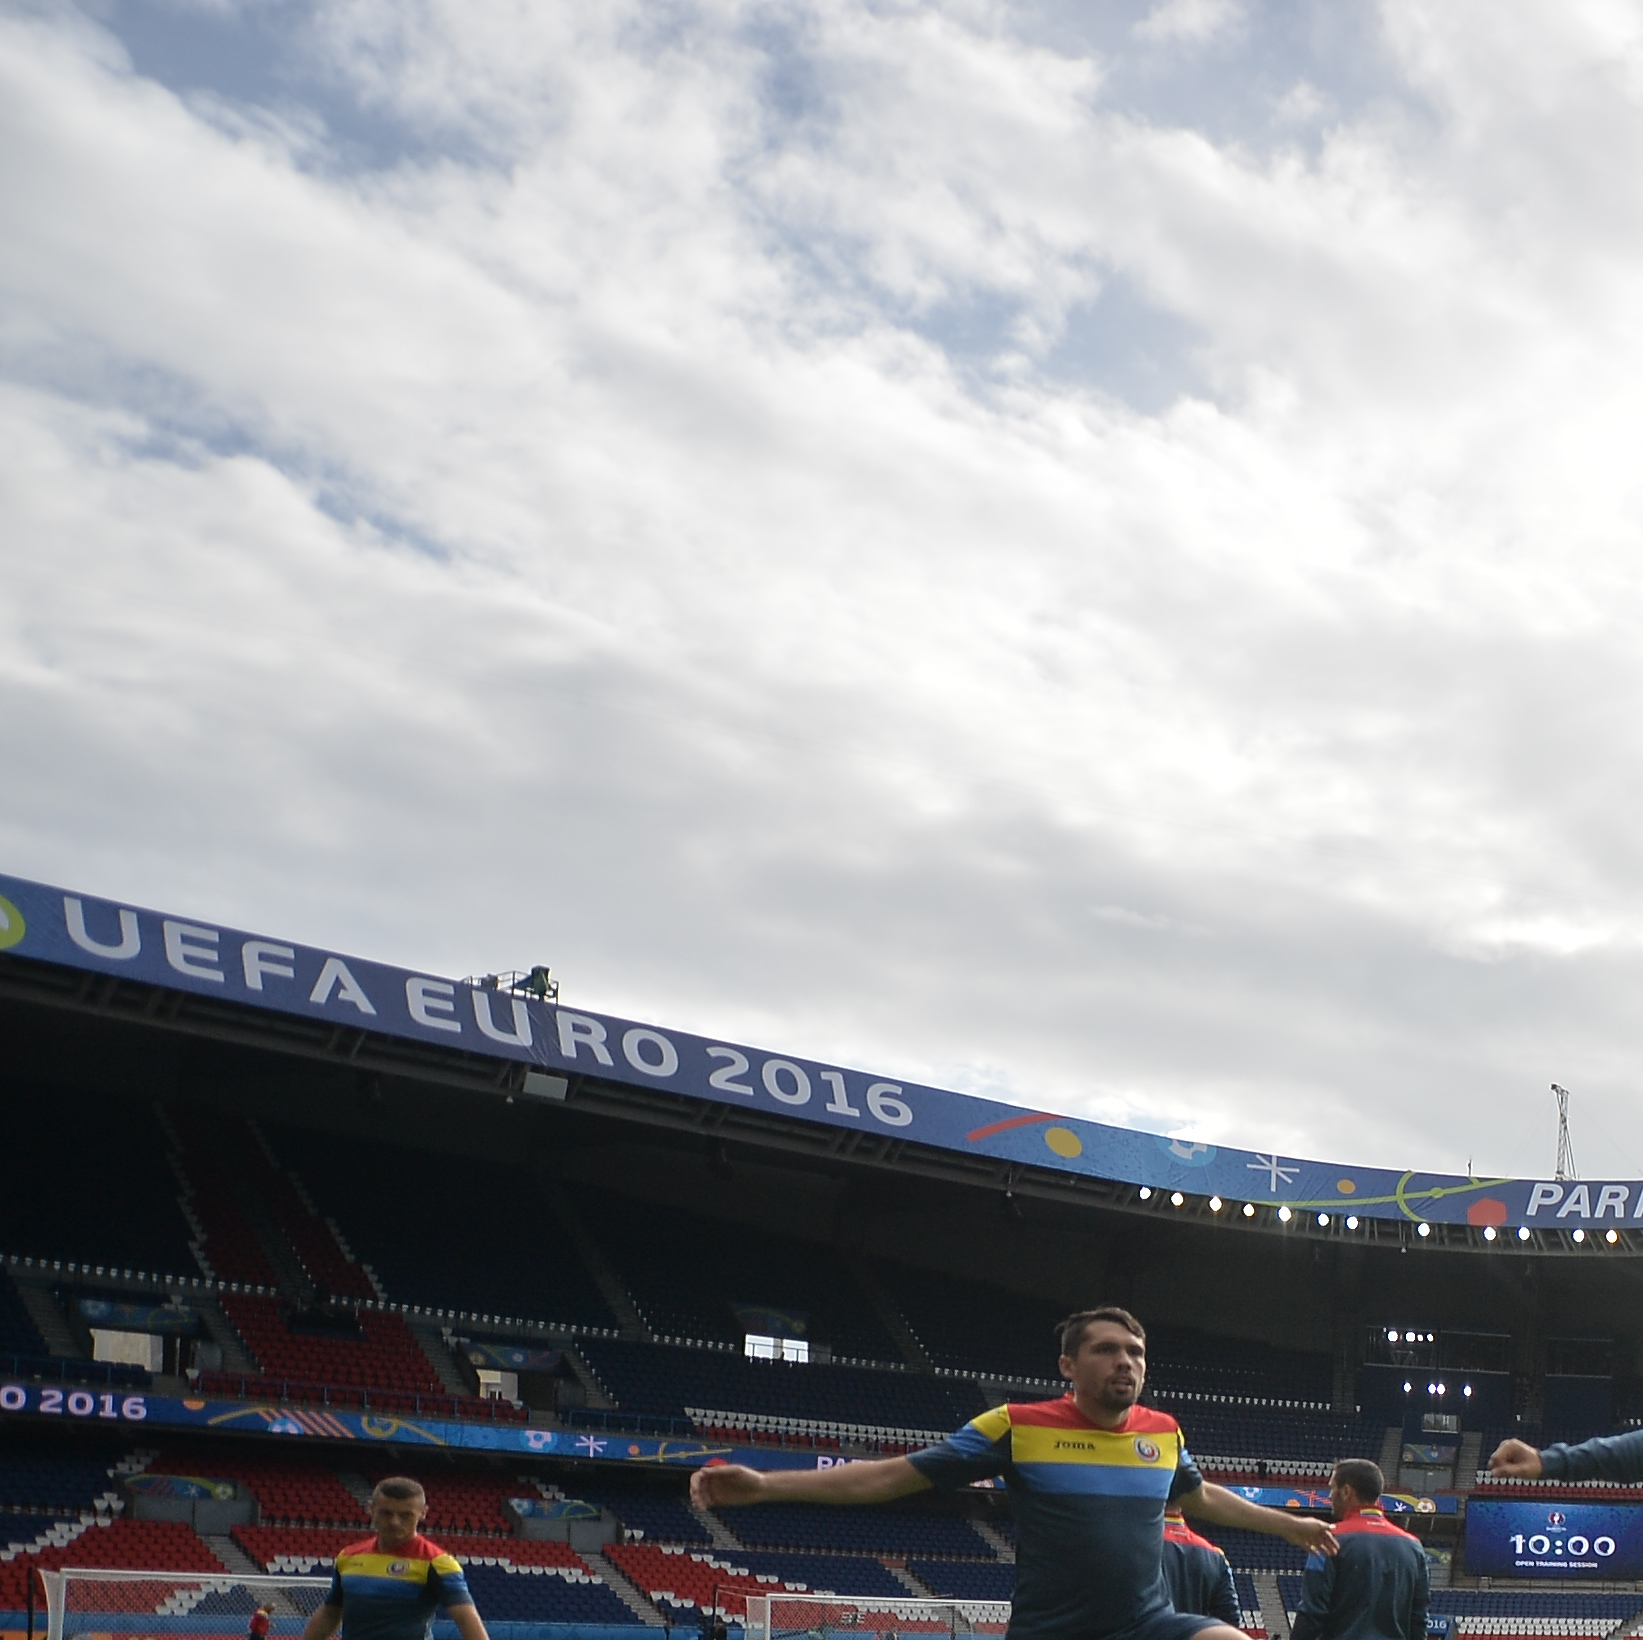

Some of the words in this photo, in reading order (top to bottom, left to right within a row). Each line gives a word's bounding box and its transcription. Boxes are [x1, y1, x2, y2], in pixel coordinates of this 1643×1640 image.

[63, 896, 377, 1016] UEFA
[404, 976, 680, 1077] EURO
[705, 1046, 914, 1127] 2016
[39, 1388, 148, 1421] 2016
[1510, 1534, 1616, 1557] 10:00
